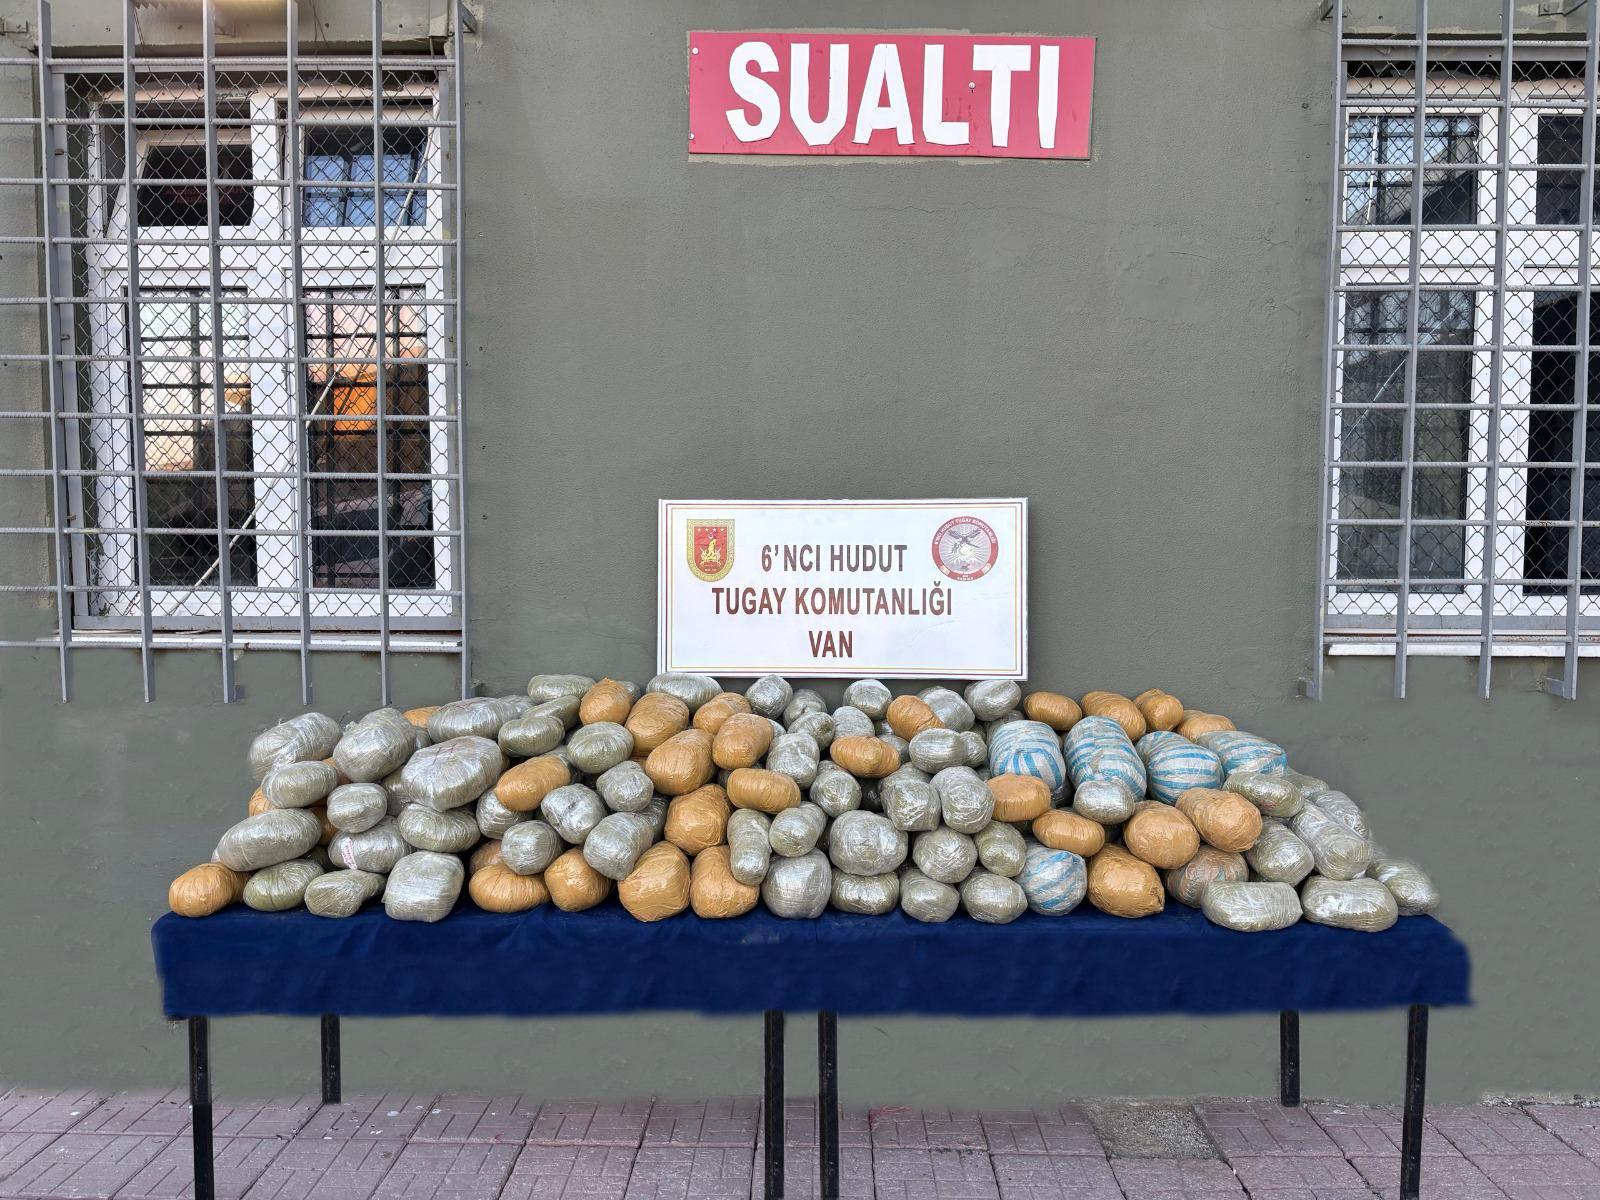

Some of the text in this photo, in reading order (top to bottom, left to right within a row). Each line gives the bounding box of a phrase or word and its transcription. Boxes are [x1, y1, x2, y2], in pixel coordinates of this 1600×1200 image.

[725, 41, 1060, 149] SUALTI
[761, 544, 908, 573] 6'NCI HUDUT
[711, 580, 953, 616] TUGAY KOMUTANLIĞI
[808, 630, 853, 658] VAN
